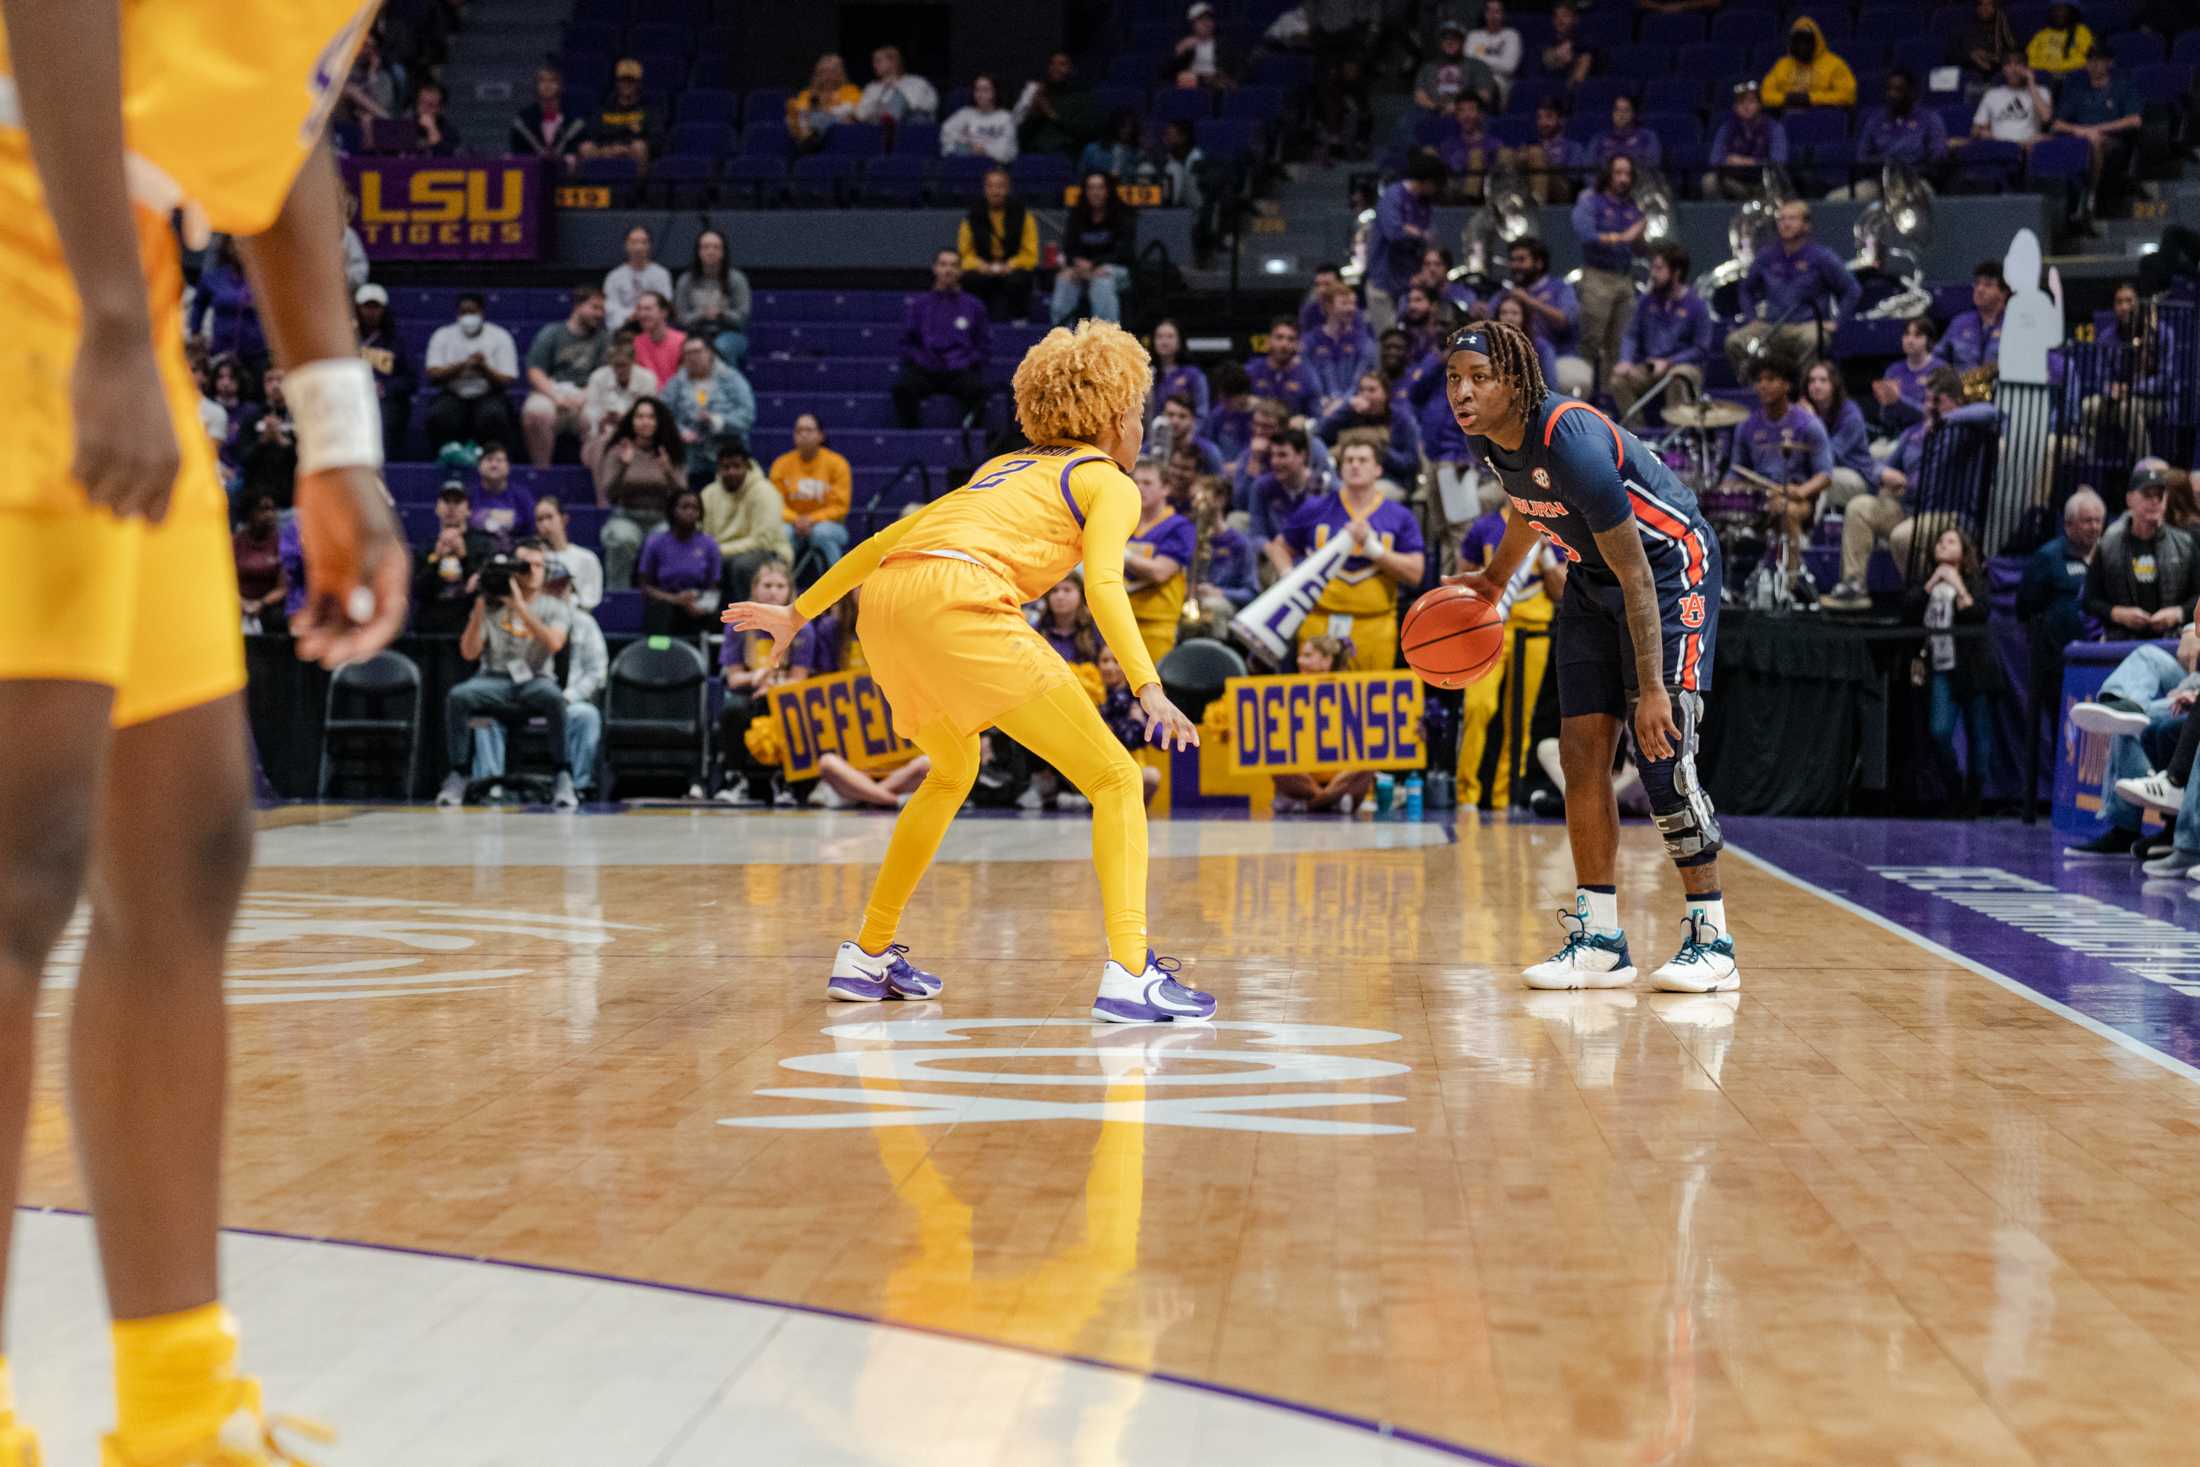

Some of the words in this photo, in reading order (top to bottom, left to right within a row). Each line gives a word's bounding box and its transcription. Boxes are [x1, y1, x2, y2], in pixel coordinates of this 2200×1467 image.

[361, 170, 524, 222] LSU
[363, 223, 522, 244] TIGERS
[967, 460, 1038, 489] 2
[779, 675, 912, 770] DEFE
[1237, 680, 1417, 766] DEFENSE
